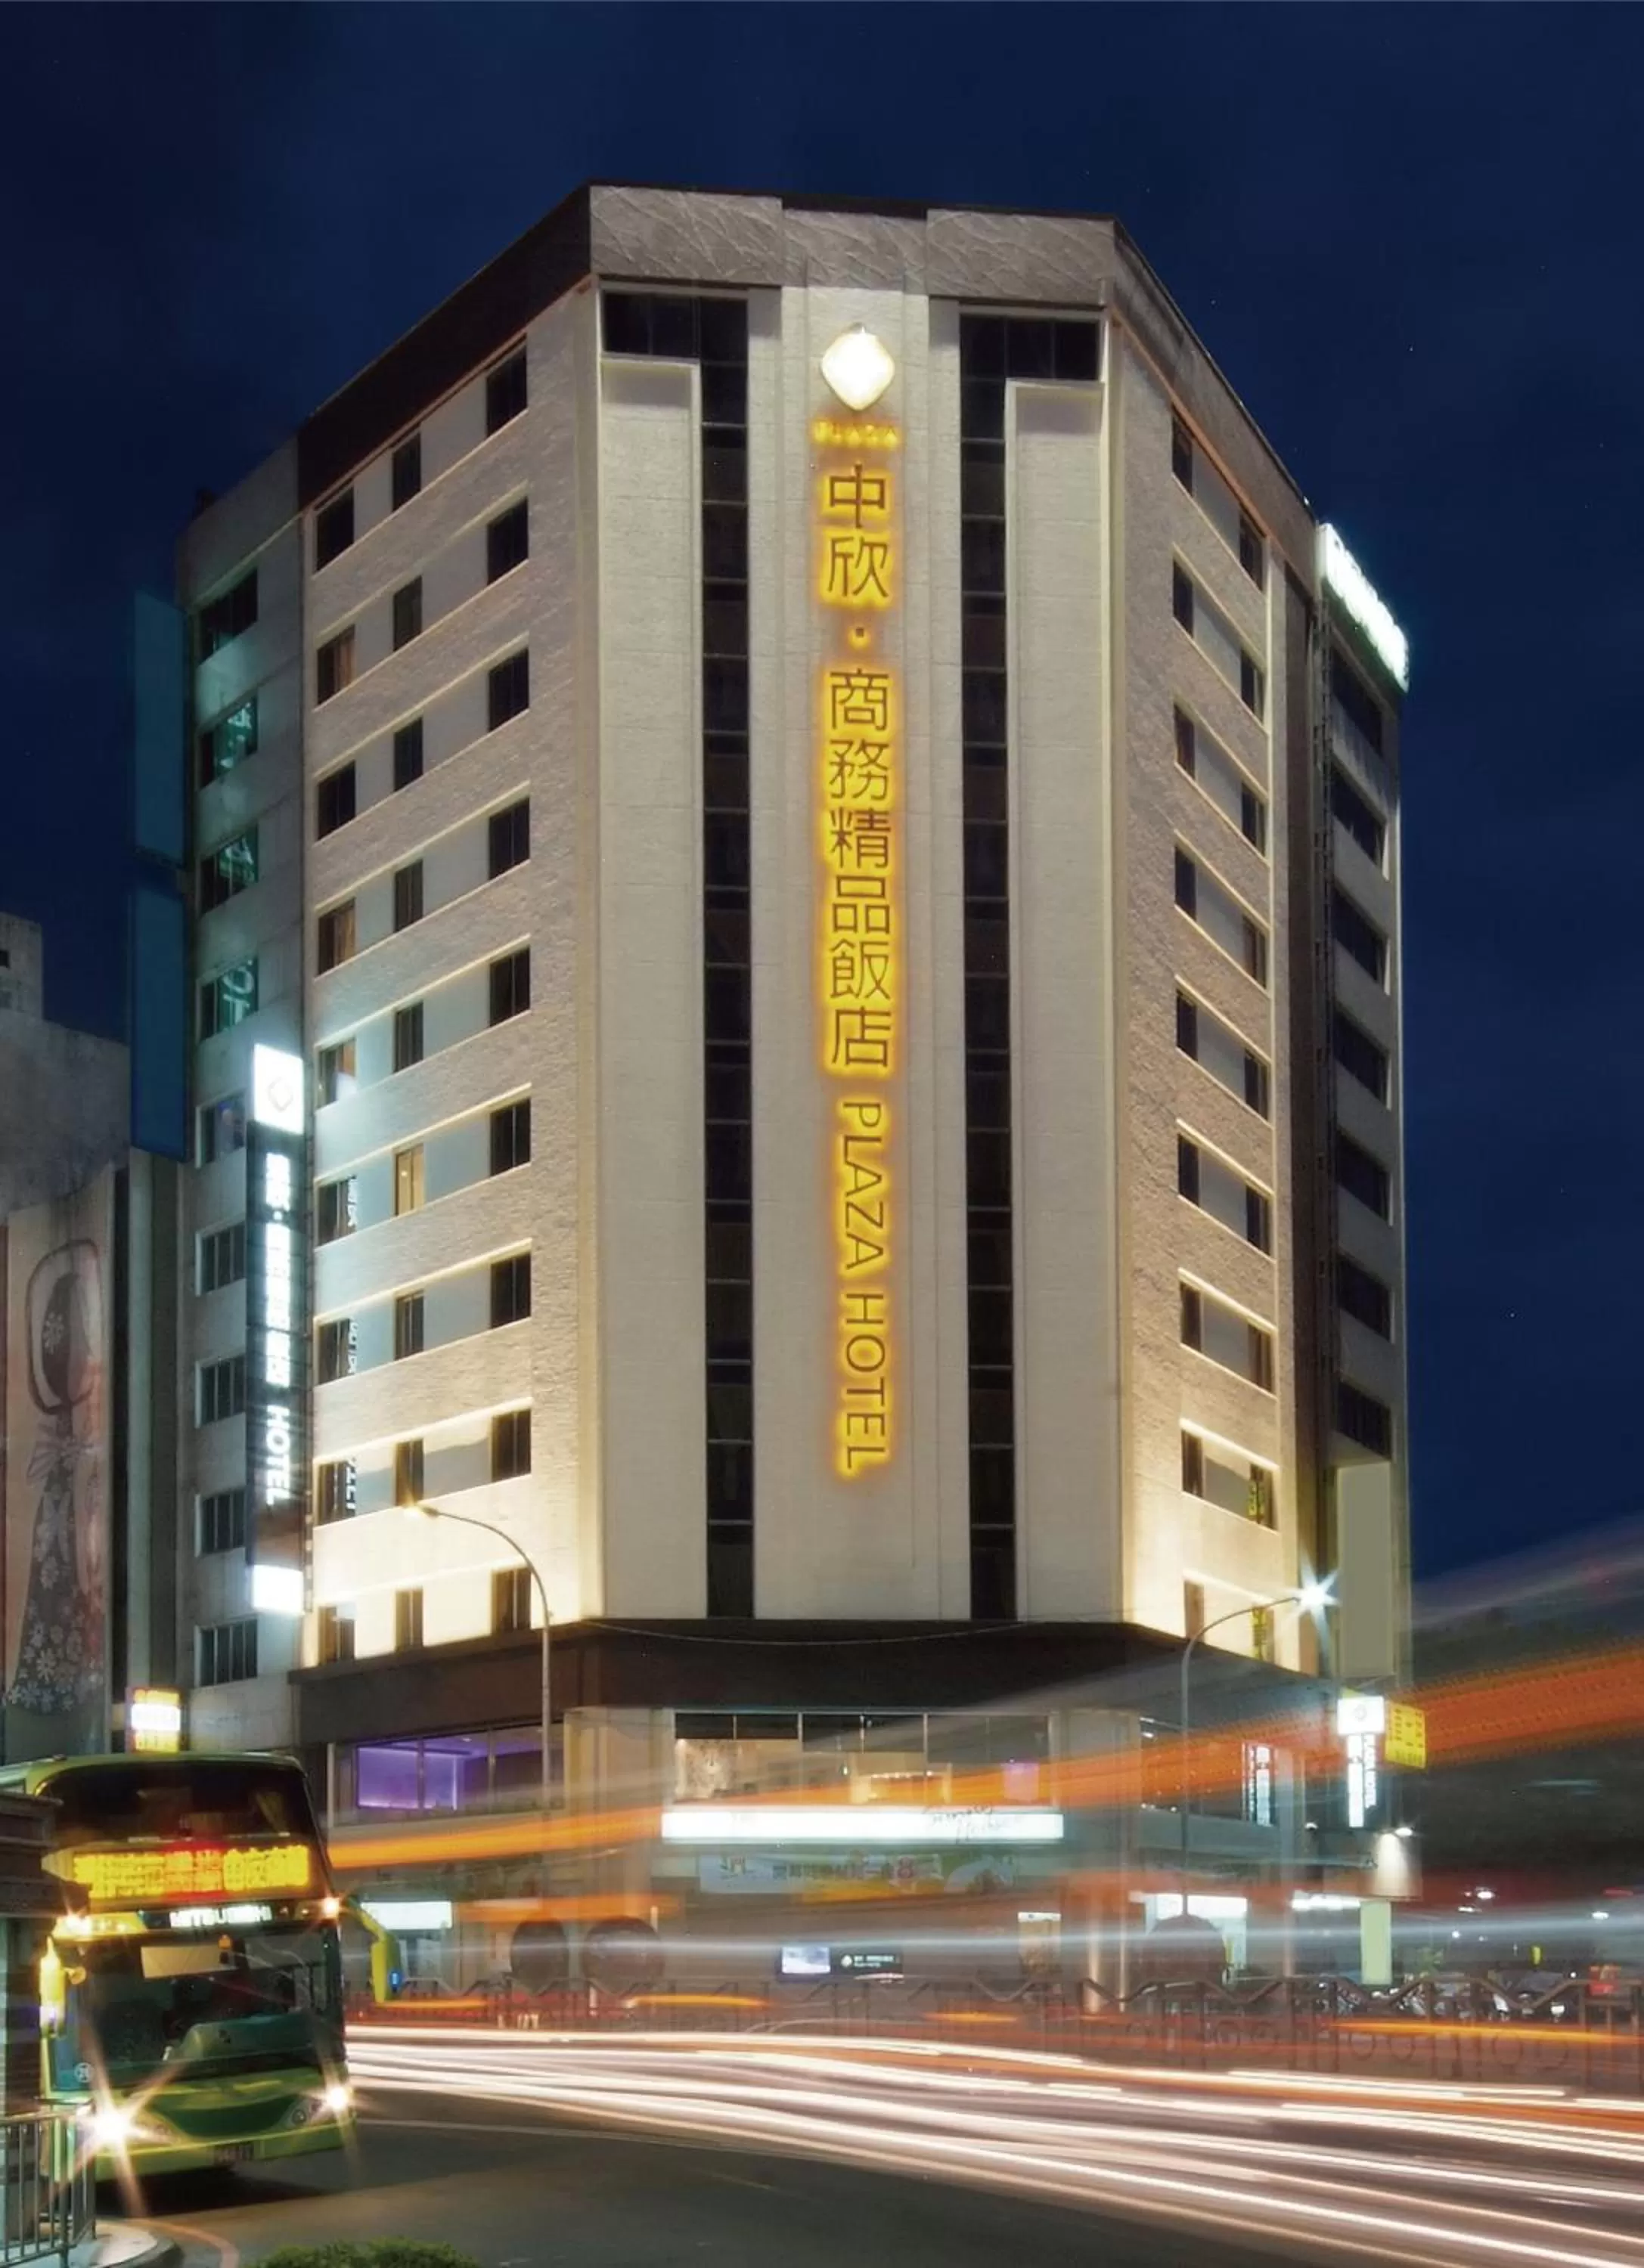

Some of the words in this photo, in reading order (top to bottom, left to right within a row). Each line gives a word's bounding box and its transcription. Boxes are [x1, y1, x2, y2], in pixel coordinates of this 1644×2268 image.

[842, 1101, 884, 1270] PLAZA
[266, 1403, 291, 1506] HOTEL
[845, 1292, 886, 1469] HOTEL
